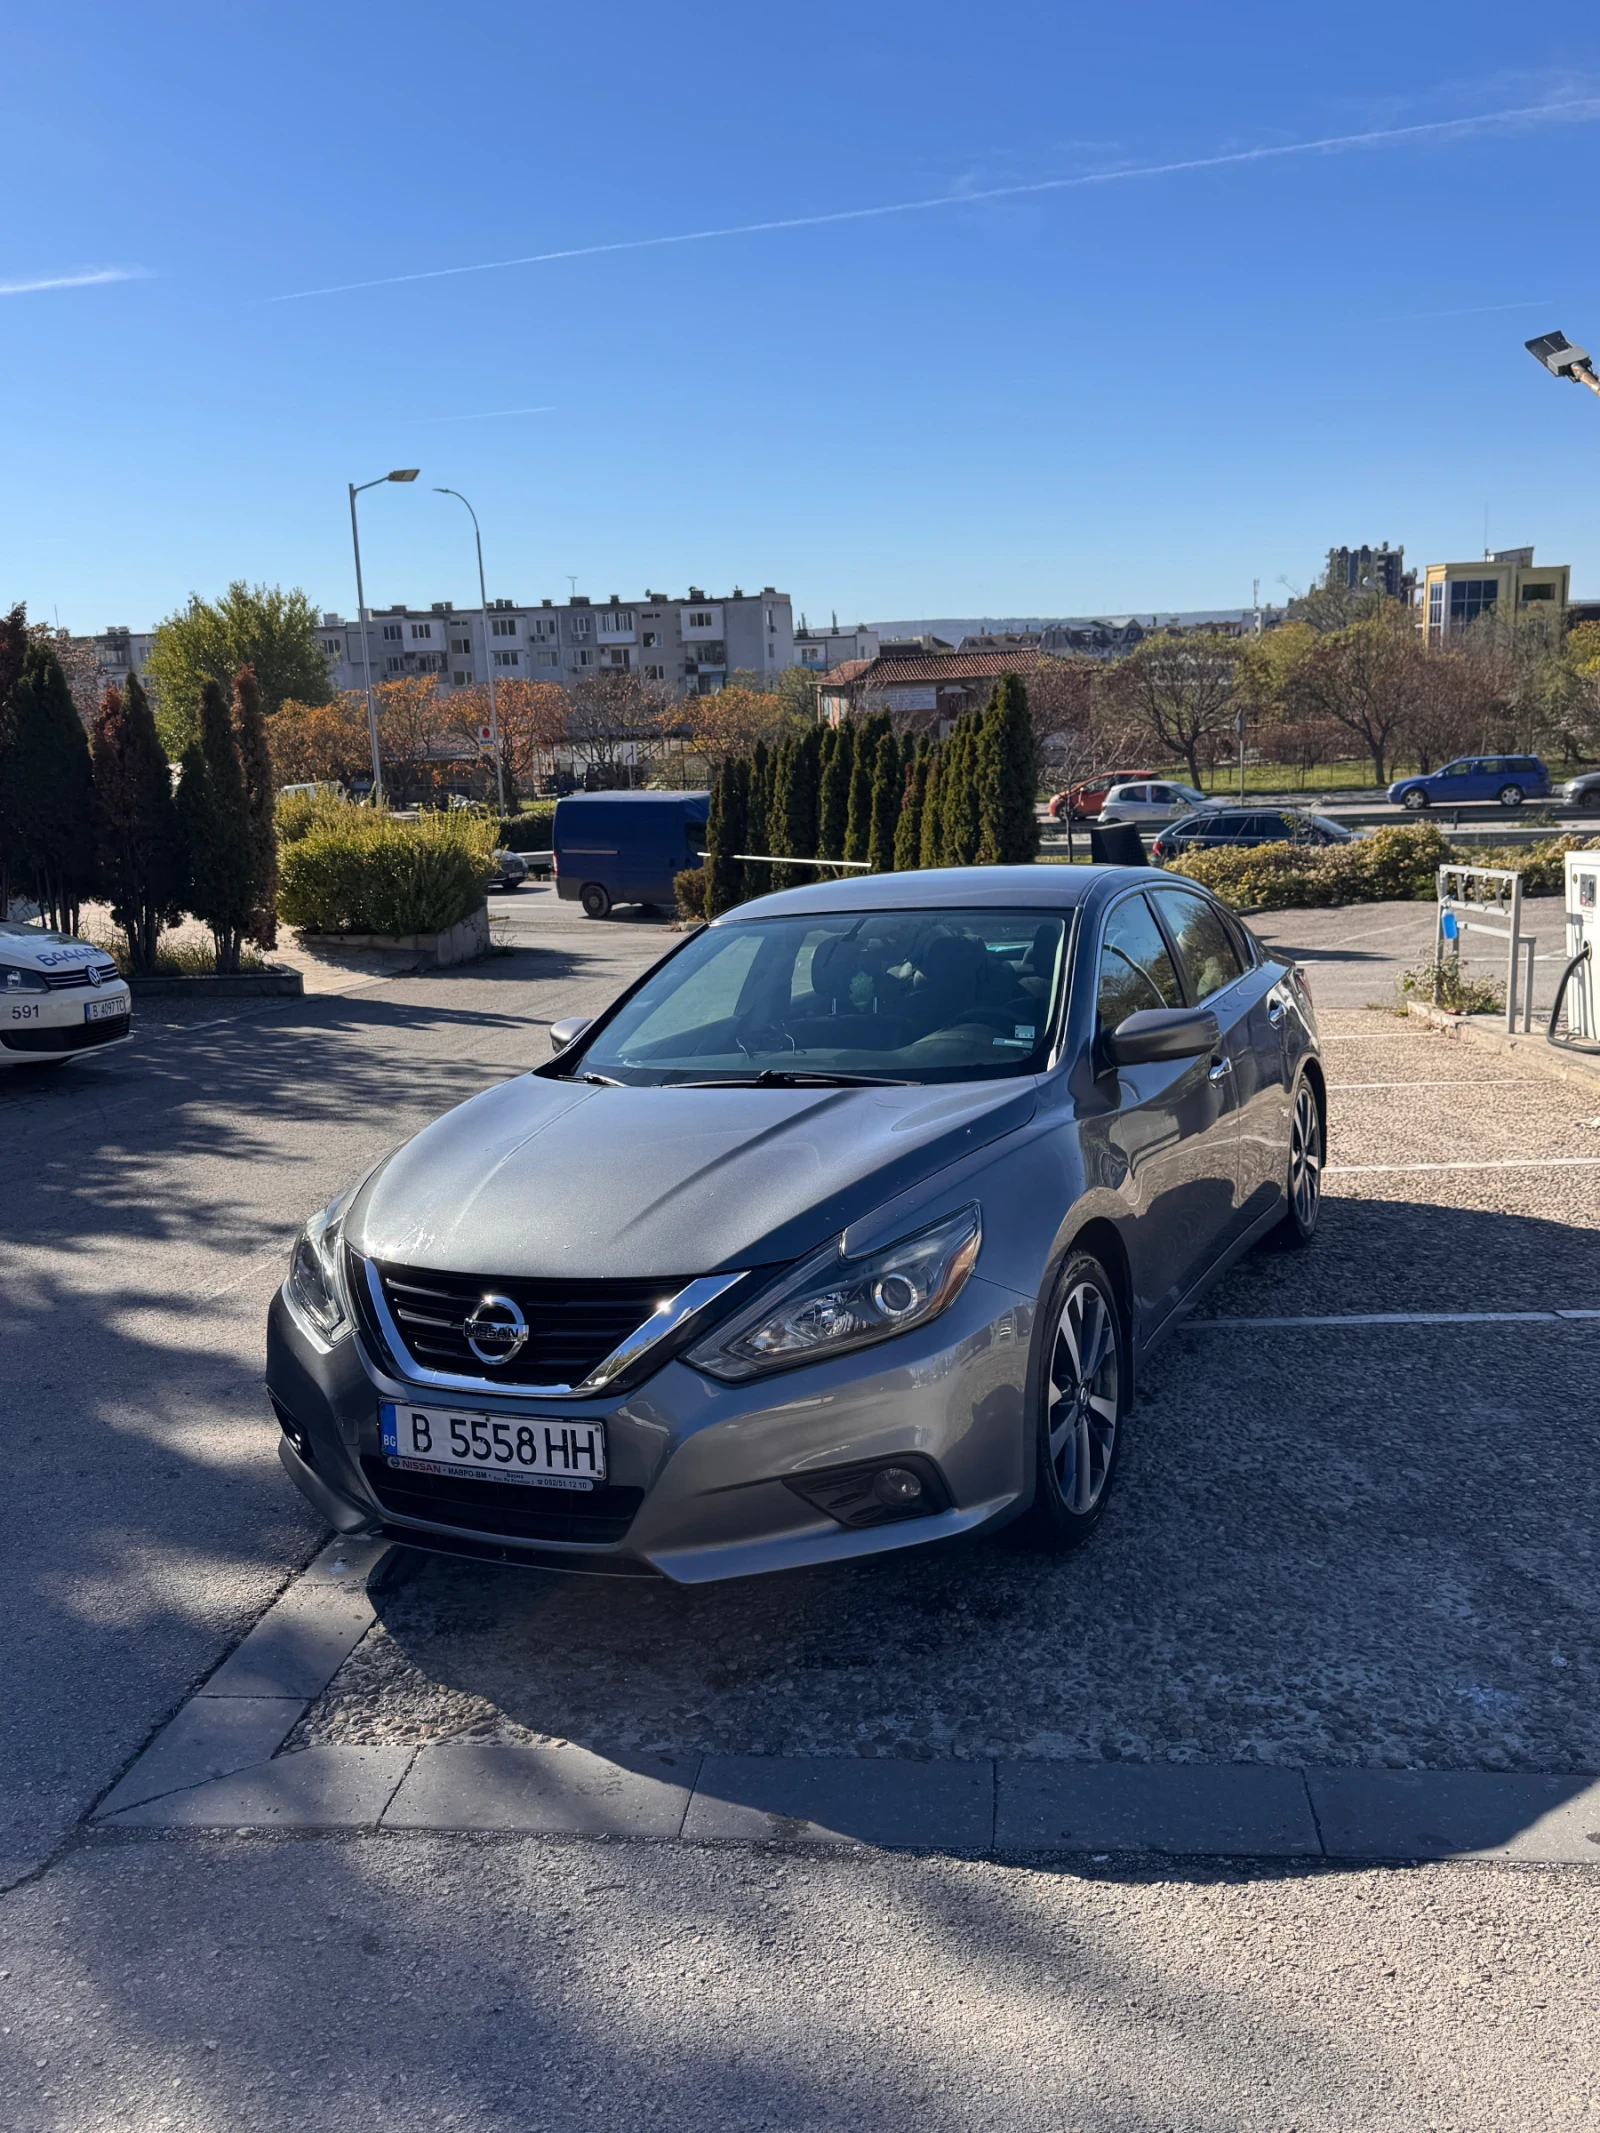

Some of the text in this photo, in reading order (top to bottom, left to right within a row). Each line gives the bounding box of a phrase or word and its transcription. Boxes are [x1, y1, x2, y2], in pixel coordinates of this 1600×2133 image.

[12, 1005, 39, 1019] 591
[383, 1434, 397, 1447] BG
[411, 1412, 597, 1471] B 5558 HH
[402, 1460, 441, 1474] NISSAN
